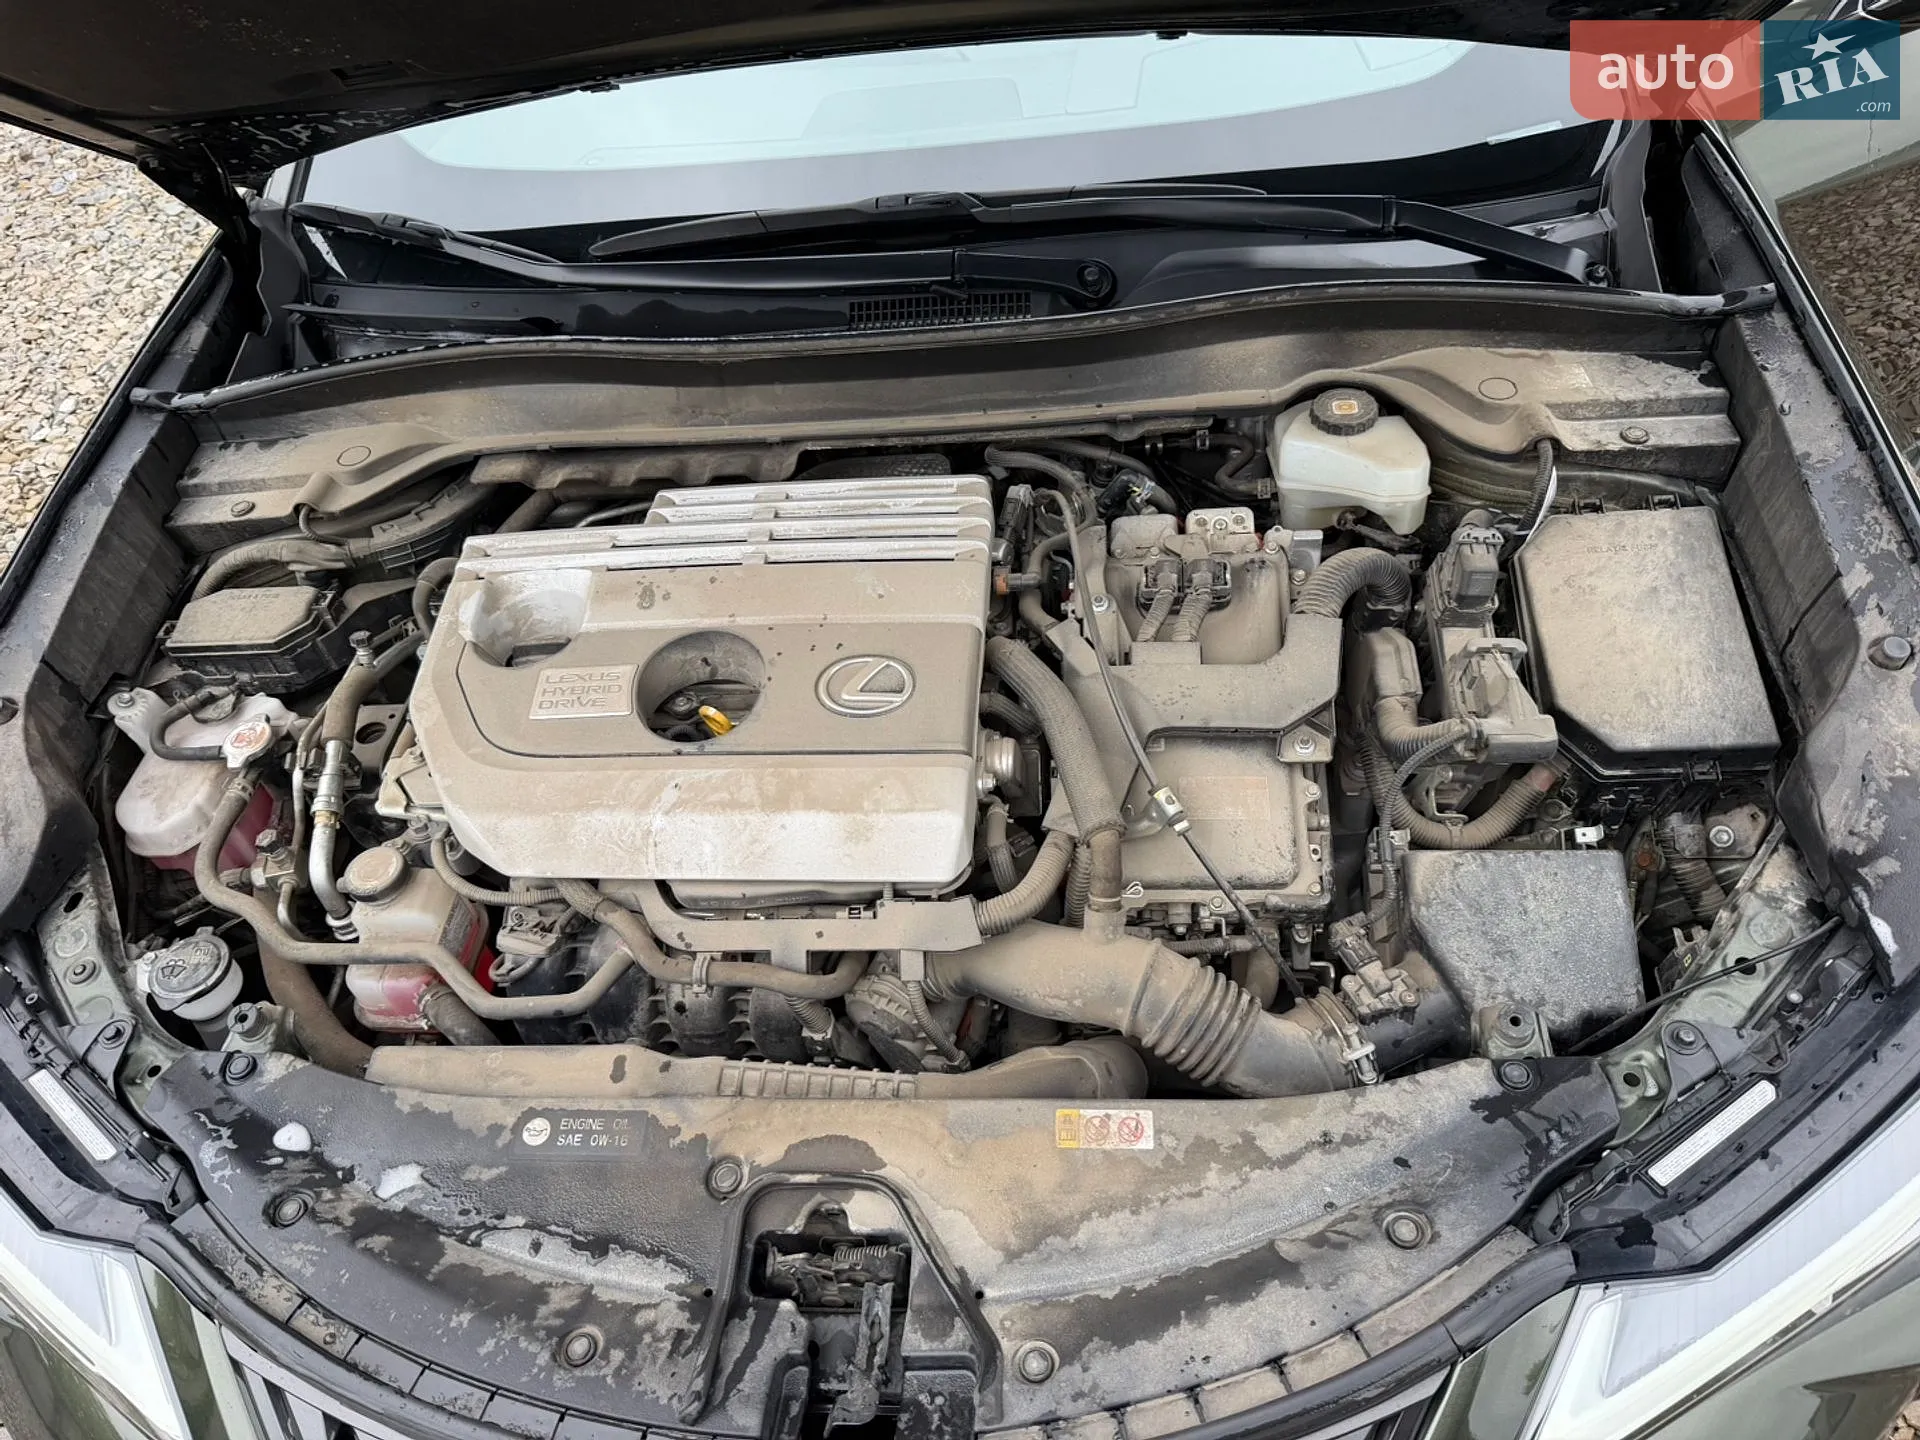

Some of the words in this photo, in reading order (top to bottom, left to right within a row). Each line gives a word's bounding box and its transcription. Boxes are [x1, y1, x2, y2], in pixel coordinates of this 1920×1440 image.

[545, 672, 621, 684] LEXUS
[541, 684, 622, 697] HYBRID
[538, 697, 607, 709] DRIVE
[560, 1118, 605, 1130] ENGINE
[557, 1134, 583, 1146] SAE
